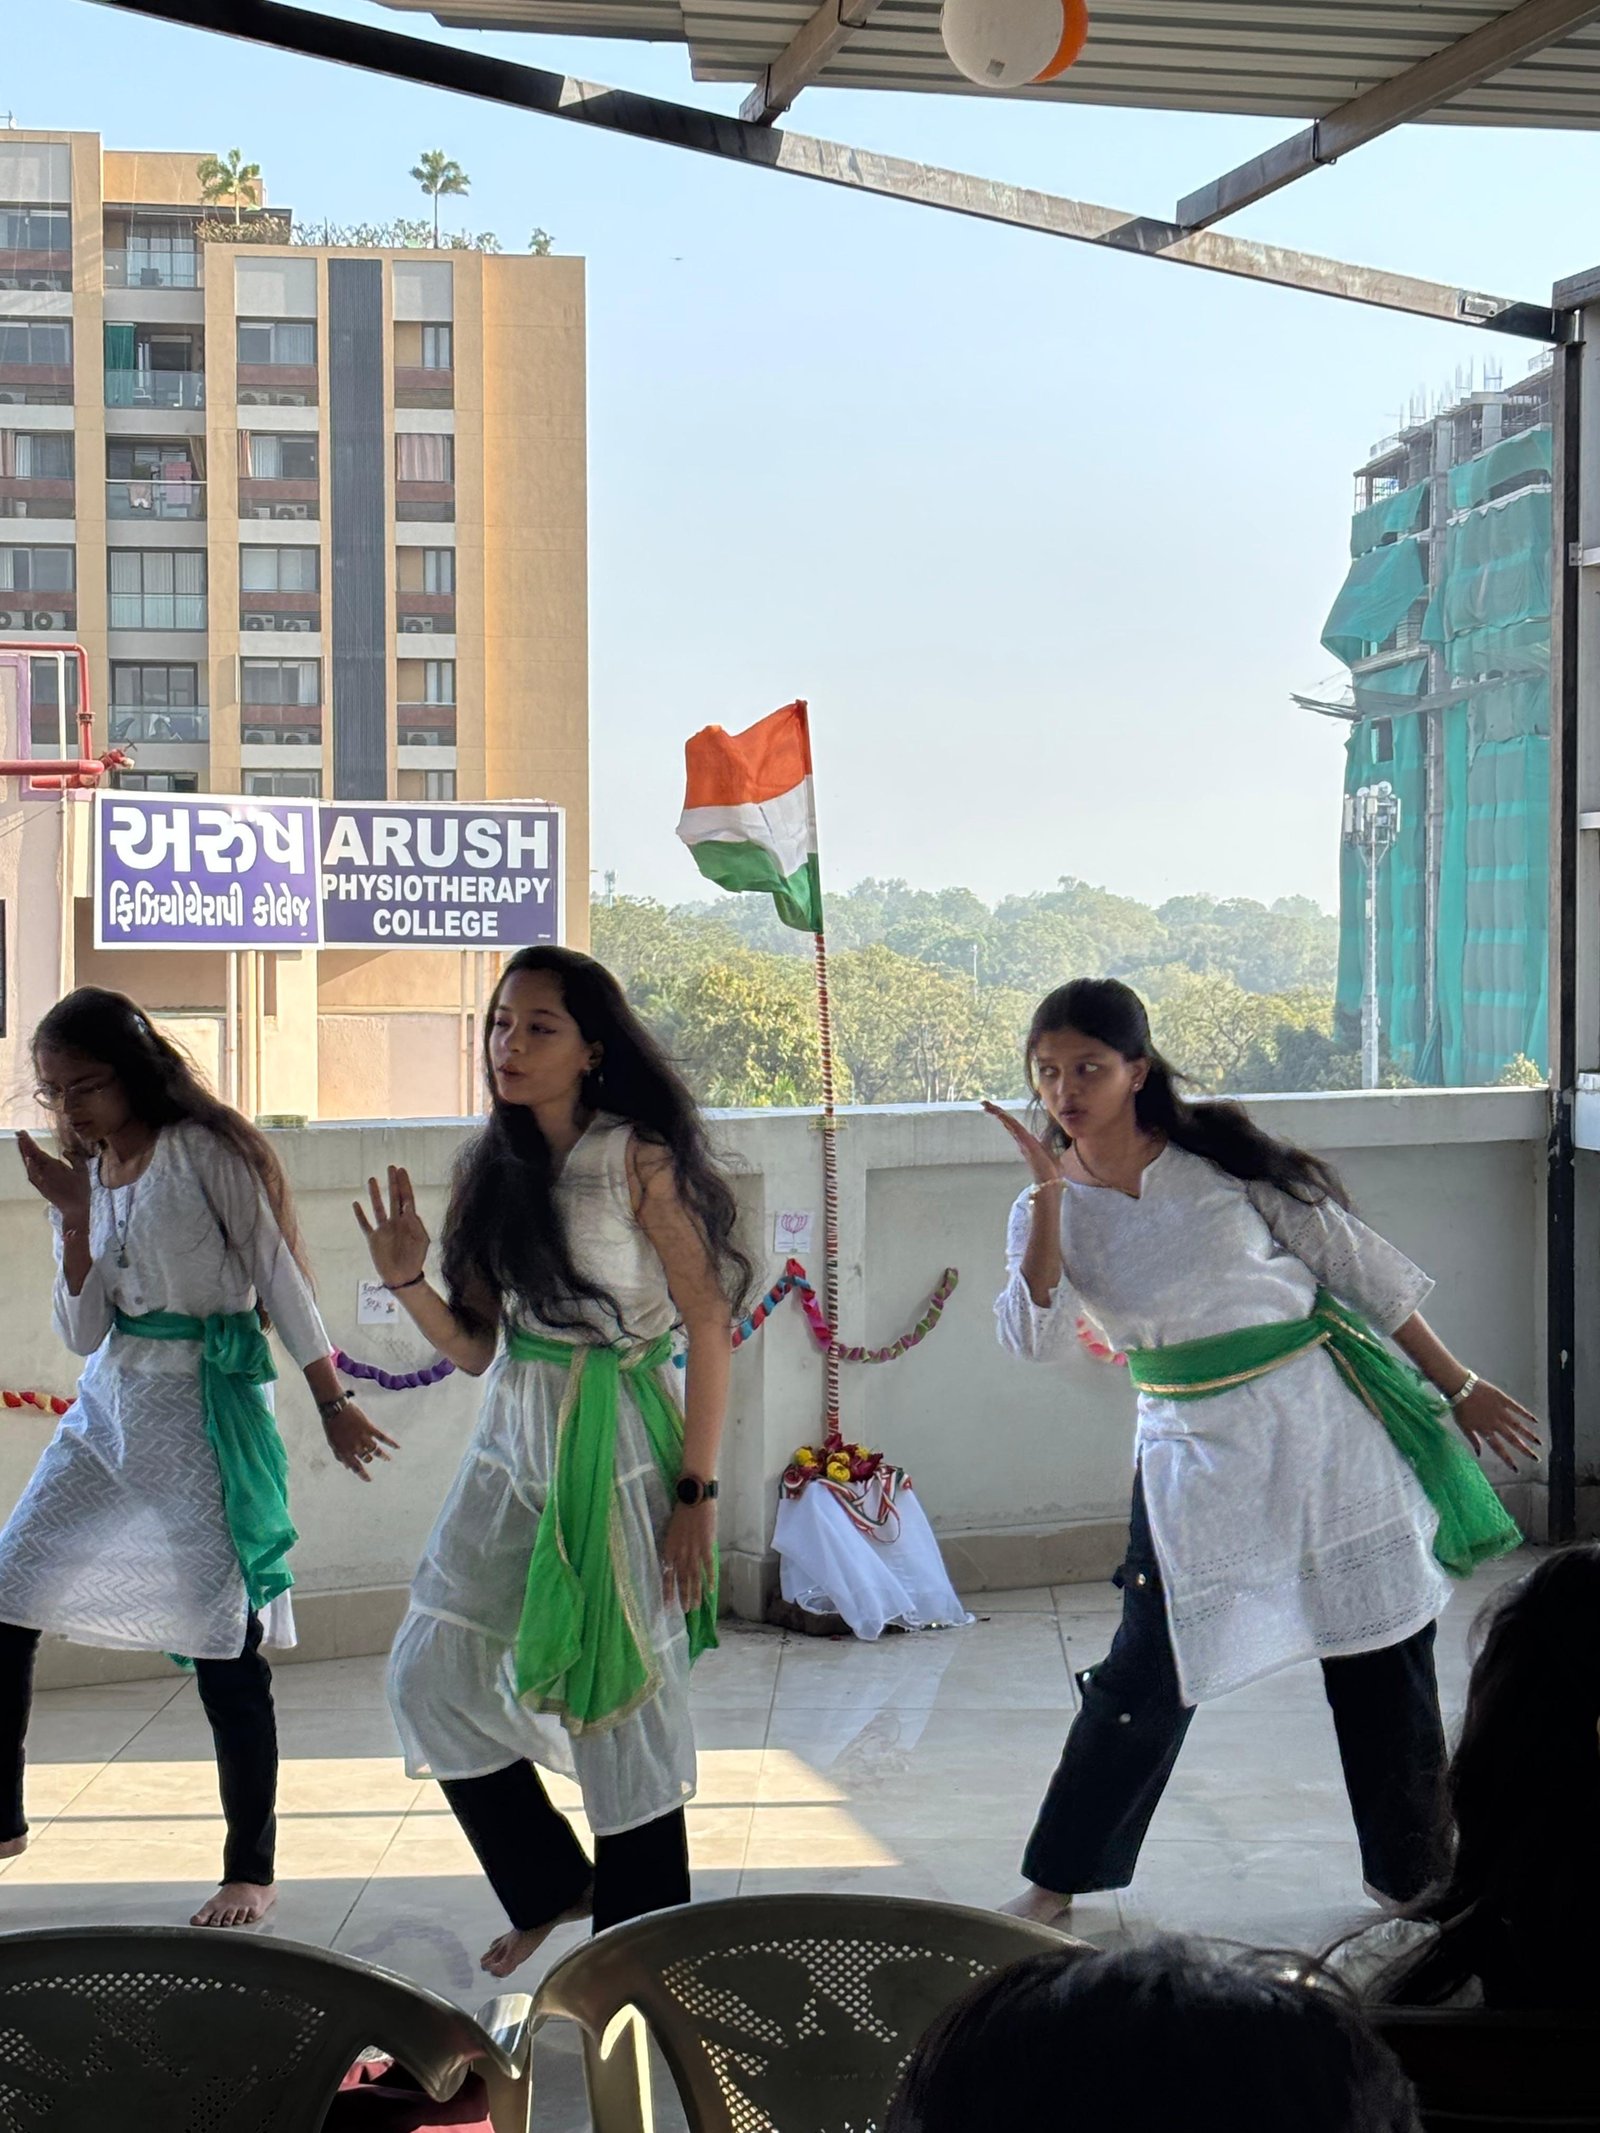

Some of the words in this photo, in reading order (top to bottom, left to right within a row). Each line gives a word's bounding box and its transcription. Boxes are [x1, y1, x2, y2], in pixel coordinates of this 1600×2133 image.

[323, 816, 549, 869] ARUSH
[109, 880, 244, 932] ફિઝિયોથેરાપી
[252, 882, 311, 927] કોલેજ
[322, 874, 551, 904] PHYSIOTHERAPY
[373, 909, 498, 938] COLLEGE
